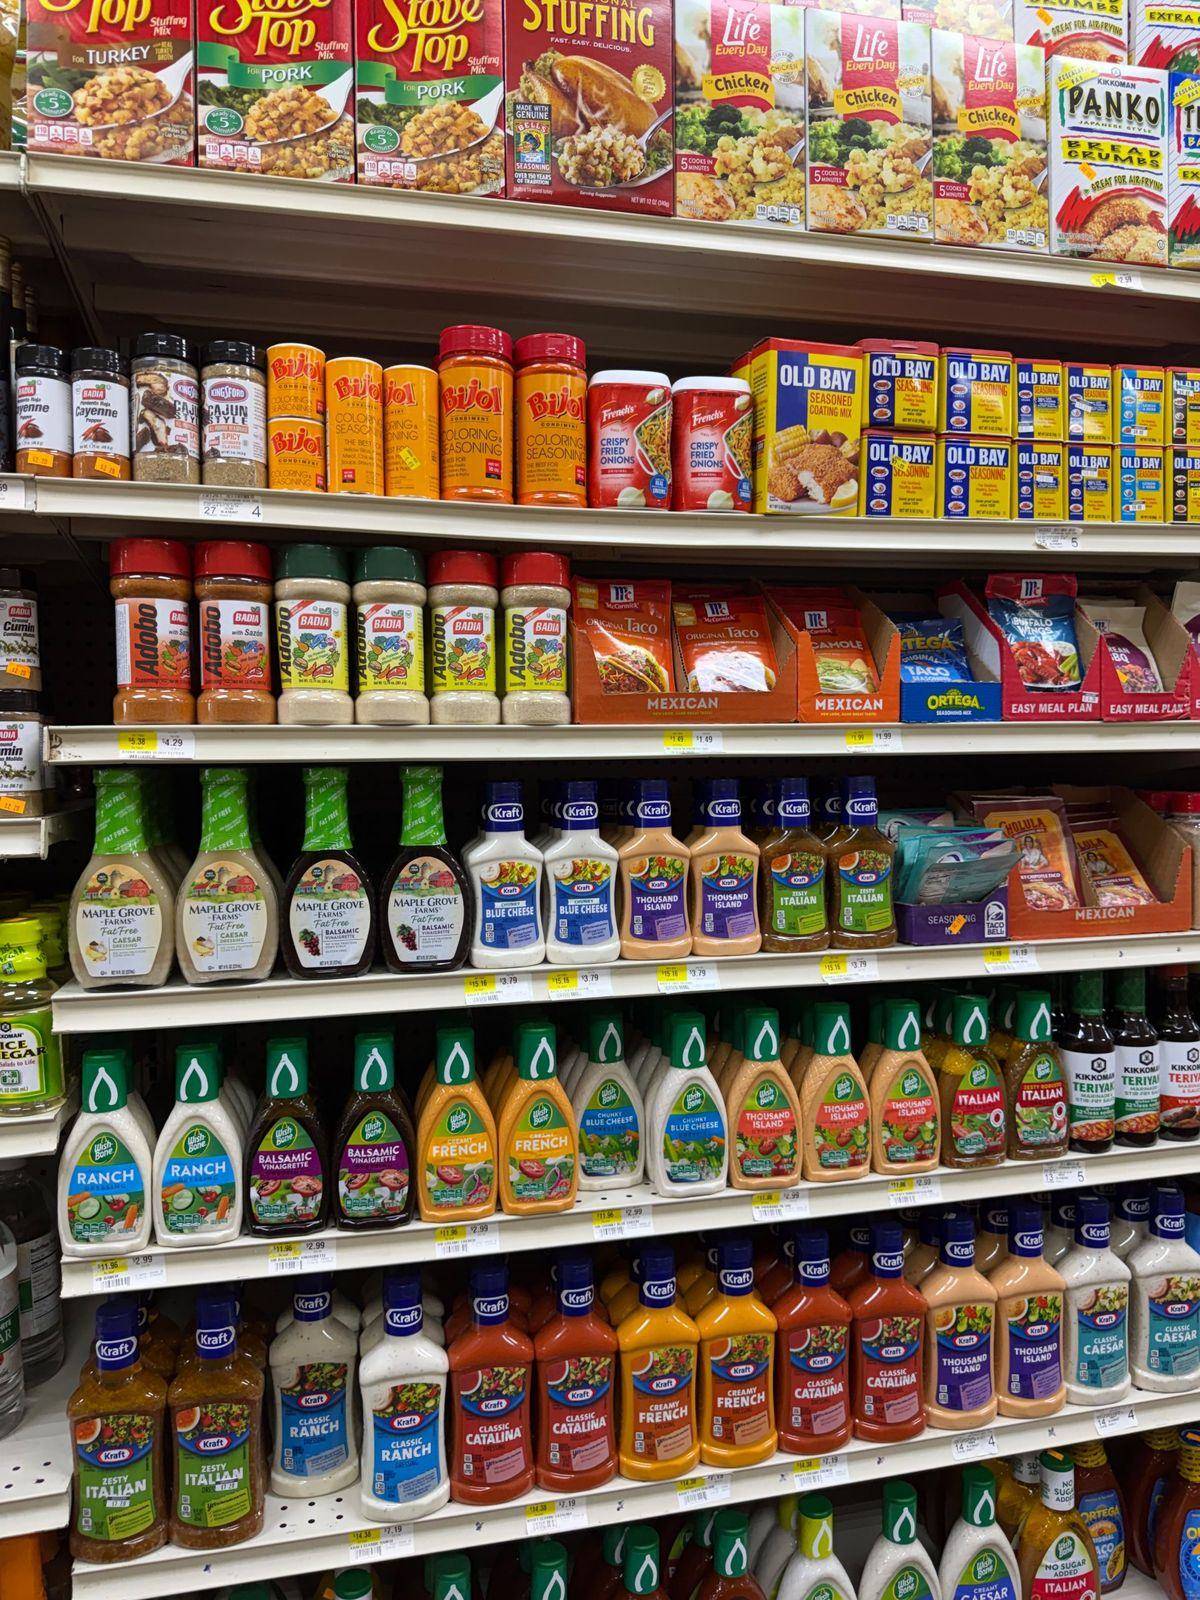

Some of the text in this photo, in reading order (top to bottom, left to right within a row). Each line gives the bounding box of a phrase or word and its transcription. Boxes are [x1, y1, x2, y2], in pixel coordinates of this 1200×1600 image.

[150, 15, 188, 28] Stuffing
[522, 0, 655, 47] STUFFING
[722, 7, 761, 46] Life
[153, 26, 172, 35] Mix
[253, 17, 316, 56] Top
[314, 41, 349, 52] Stuffing
[410, 32, 469, 73] Top
[593, 42, 632, 53] DELICIOUS.
[715, 44, 768, 58] Every Day
[87, 46, 150, 65] TURKEY
[317, 51, 334, 60] Mix
[261, 65, 312, 83] PORK
[714, 72, 769, 93] Chicken
[1097, 78, 1136, 90] KIKKOMAN
[417, 81, 466, 100] PORK
[516, 104, 532, 112] MADE
[1068, 86, 1161, 126] PANKO
[516, 110, 549, 120] GENUINE
[1067, 140, 1161, 159] BREAD
[681, 158, 688, 170] 5
[1067, 149, 1161, 169] CRUMBS
[1091, 178, 1113, 191] GREAT
[1114, 175, 1127, 185] FOR
[270, 353, 323, 383] Bijol
[872, 359, 932, 379] OLD BAY
[949, 361, 1009, 382] OLD BAY
[780, 364, 852, 391] OLD BAY
[1018, 371, 1059, 386] OLD BAY
[210, 387, 245, 398] KINGSFORD
[442, 377, 503, 416] Bijol
[809, 391, 853, 407] SEASONED
[208, 405, 248, 417] CAJUN
[526, 387, 585, 423] Bijol
[809, 405, 852, 418] COATING MIX
[75, 405, 118, 420] Cayenne
[602, 404, 635, 422] French's
[208, 416, 248, 424] STYLE
[526, 434, 584, 448] COLORING
[600, 437, 630, 447] CRISPY
[526, 447, 586, 464] SEASONING
[600, 447, 626, 457] FRIED
[869, 443, 930, 464] OLD BAY
[947, 446, 1007, 466] OLD BAY
[600, 456, 635, 465] ONIONS
[1121, 456, 1162, 469] OLD BAY
[970, 465, 1006, 481] SEASONING
[1071, 537, 1079, 548] 5
[10, 606, 31, 617] BADIA
[233, 612, 259, 623] BADIA
[3, 621, 35, 633] Cumin
[454, 621, 482, 632] BADIA
[535, 622, 560, 633] BADIA
[625, 617, 658, 634] Taco
[1012, 617, 1053, 628] BUFFALO
[686, 626, 759, 641] ORIGINAL Taco
[1018, 626, 1051, 634] WINGS
[134, 603, 158, 677] Adobo
[204, 605, 222, 678] Adobo
[432, 613, 446, 681] Adobo
[509, 613, 526, 681] Adobo
[647, 698, 719, 710] MEXICAN
[815, 698, 883, 711] MEXICAN
[928, 694, 980, 711] ORTEGA
[1011, 702, 1093, 714] EASY MEAL PLAN
[494, 806, 520, 818] Kraft
[786, 802, 810, 814] Kraft
[502, 886, 518, 895] Kraft
[296, 900, 364, 912] MAPLE GROVE
[635, 894, 679, 905] THOUSAND
[780, 896, 816, 906] ITALIAN
[82, 907, 155, 919] MAPLE GROVE
[486, 906, 534, 918] BLUE CHEESE
[644, 902, 672, 911] ISLAND
[1075, 908, 1135, 920] MEXICAN
[100, 926, 139, 936] Fat Free
[986, 921, 1004, 929] TACO
[325, 928, 359, 936] BALSAMIC
[987, 929, 1005, 937] BELL
[112, 936, 142, 944] CAESAR
[958, 1092, 1000, 1106] ITALIAN
[746, 1110, 790, 1120] THOUSAND
[671, 1121, 718, 1132] BLUE CHEESE
[752, 1119, 783, 1129] ISLAND
[432, 1141, 487, 1157] FRENCH
[515, 1137, 568, 1152] FRENCH
[258, 1152, 312, 1165] BALSAMIC
[171, 1161, 226, 1177] RANCH
[261, 1161, 309, 1171] VINAIGRETTE
[77, 1169, 134, 1185] RANCH
[306, 1241, 325, 1250] $2.99
[393, 1310, 418, 1323] Kraft
[1165, 1325, 1190, 1333] CLASSIC
[1155, 1331, 1198, 1343] CAESAR
[100, 1343, 129, 1357] Kraft
[1015, 1343, 1058, 1356] THOUSAND
[1023, 1353, 1052, 1364] ISLAND
[649, 1401, 680, 1411] CREAMY
[639, 1406, 688, 1423] FRENCH
[479, 1423, 510, 1433] CLASSIC
[391, 1437, 423, 1448] CLASSIC
[466, 1429, 522, 1446] CATALINA
[104, 1449, 125, 1460] Kraft
[381, 1442, 432, 1462] RANCH
[102, 1475, 128, 1486] ZESTY
[86, 1480, 146, 1499] ITALIAN
[1044, 1559, 1086, 1572] NO SUGAR
[1053, 1570, 1078, 1578] ADDED
[1045, 1579, 1087, 1594] ITALIAN
